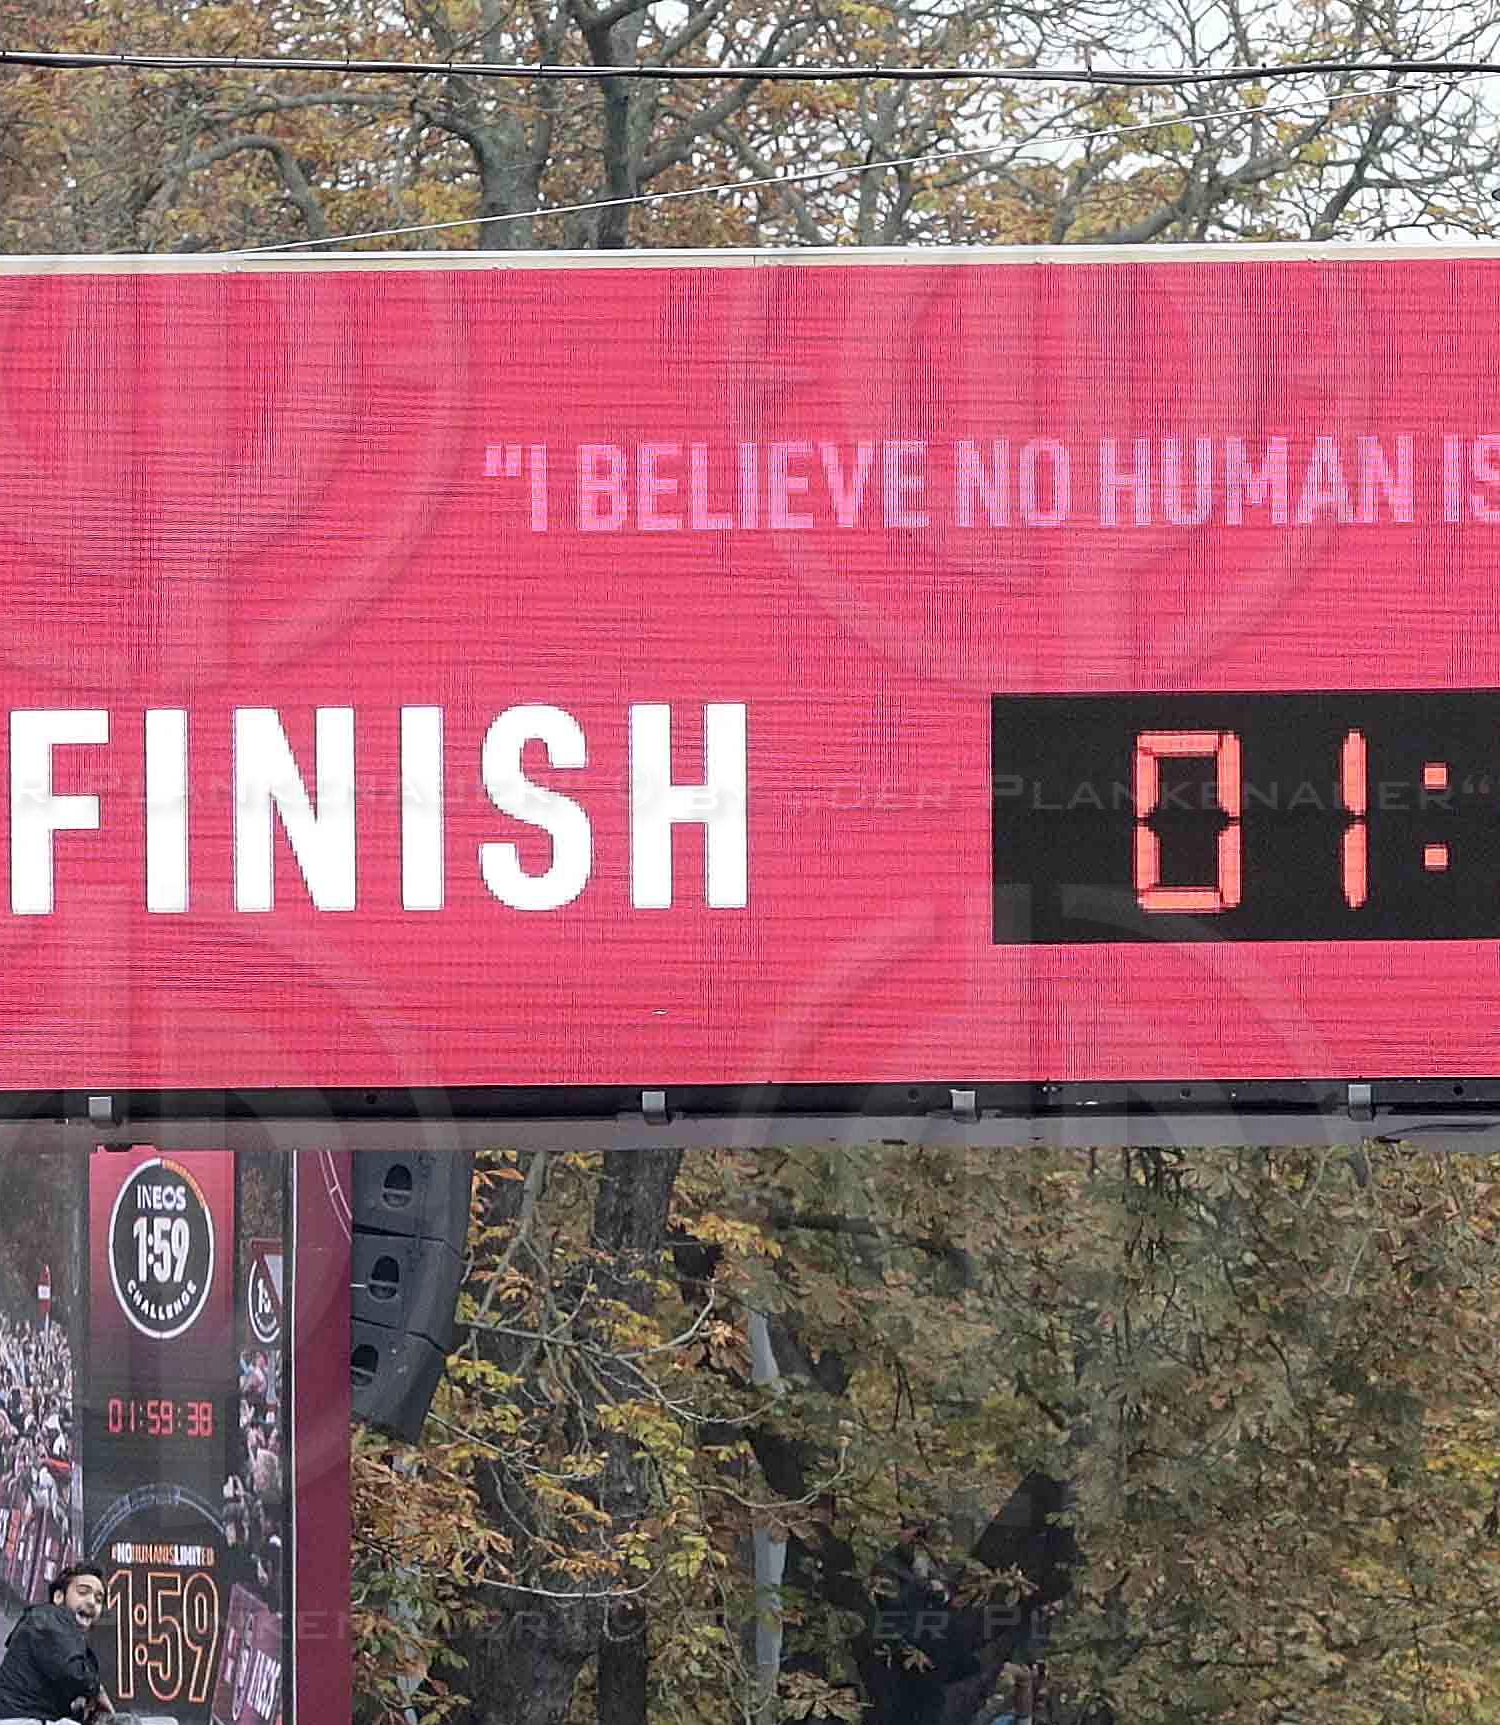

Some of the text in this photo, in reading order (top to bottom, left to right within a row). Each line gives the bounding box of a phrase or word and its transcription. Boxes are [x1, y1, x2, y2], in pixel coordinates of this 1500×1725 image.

[579, 438, 929, 533] BELIEVE
[956, 437, 1072, 529] NO
[1100, 433, 1413, 527] HUMAN
[8, 702, 748, 914] FINISH
[136, 1184, 188, 1211] INEOS
[132, 1215, 191, 1284] 1:59
[126, 1278, 198, 1322] CHALLENGE
[106, 1567, 220, 1704] 1:59
